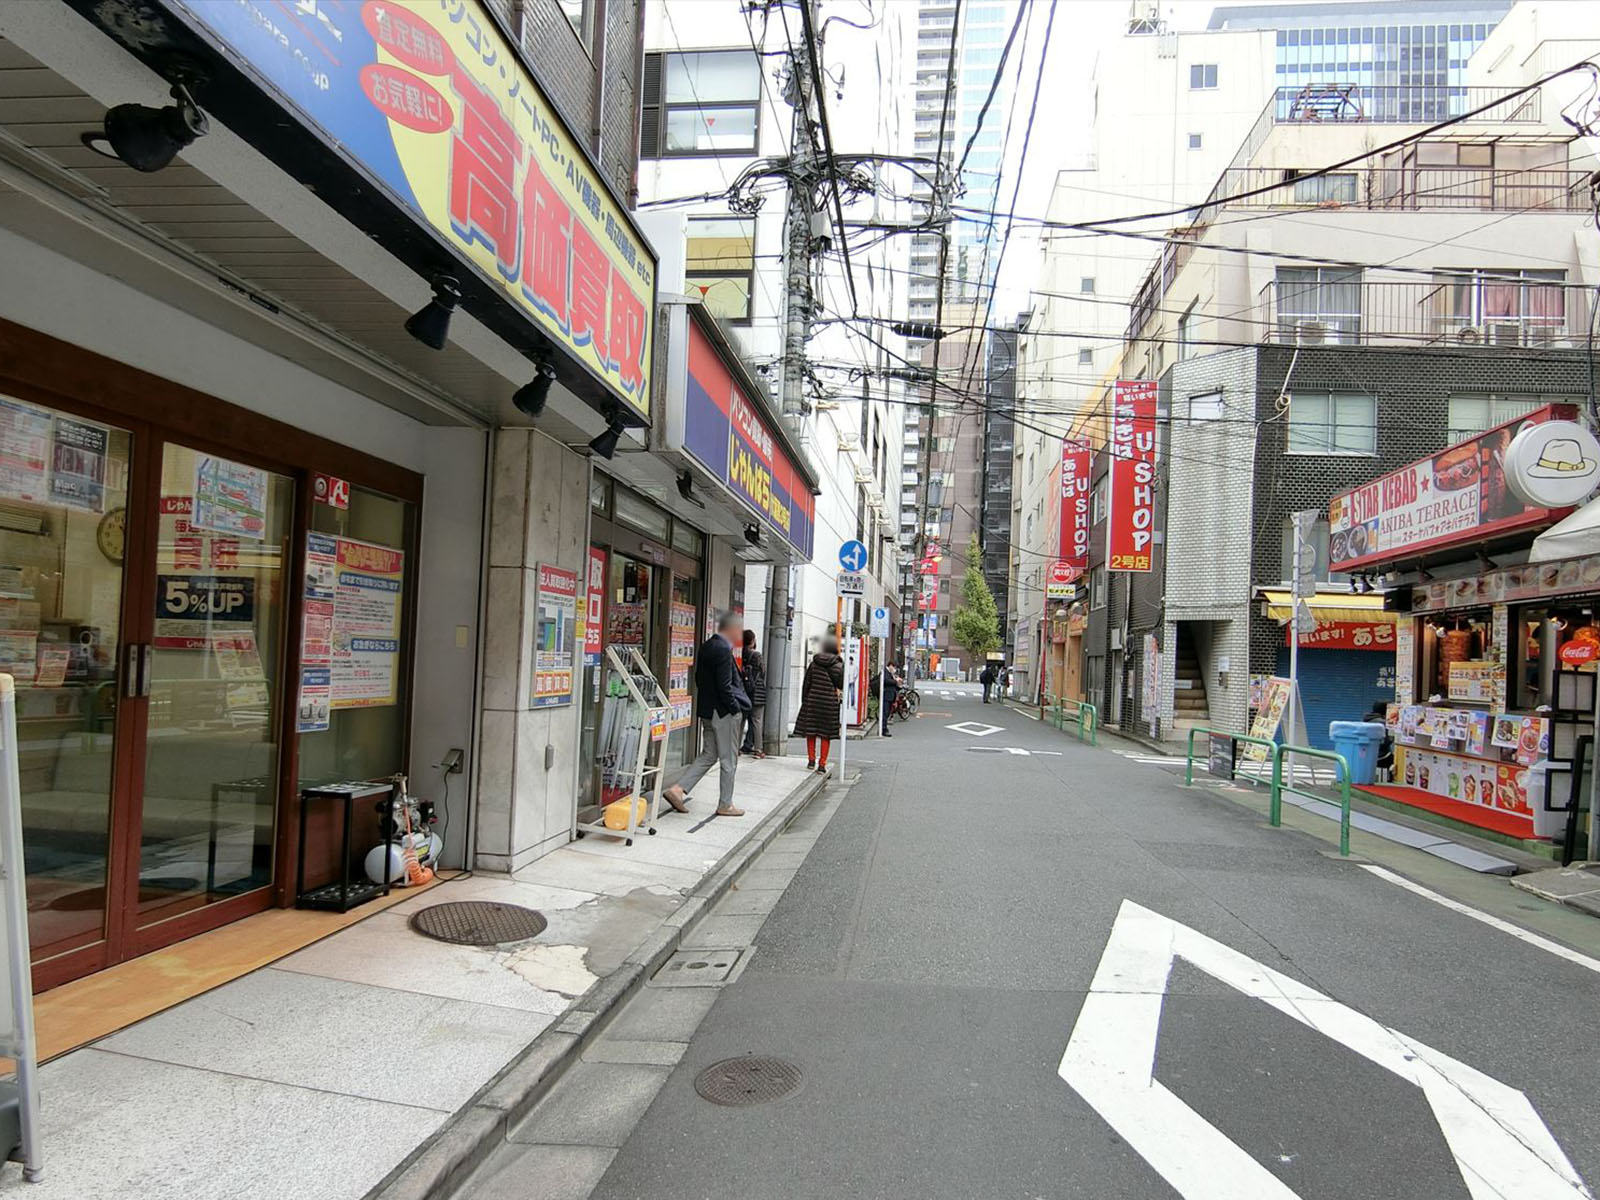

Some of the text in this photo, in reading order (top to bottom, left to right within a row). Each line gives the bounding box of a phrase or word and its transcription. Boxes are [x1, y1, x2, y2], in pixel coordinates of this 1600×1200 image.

[371, 6, 443, 69] 査定無料
[449, 57, 648, 403] 高価買取
[636, 260, 651, 287] etc
[1114, 404, 1135, 461] あきば
[730, 433, 771, 511] じゃんぱら
[1062, 459, 1077, 498] あきば
[1132, 431, 1153, 552] U-SHOP
[1350, 485, 1379, 525] STAR
[1382, 469, 1418, 512] KEBAB
[1073, 477, 1089, 557] U-SHOP
[1379, 490, 1478, 535] AKIBA TERRACE
[1111, 556, 1149, 569] 2号店
[165, 580, 244, 614] 5%UP
[1351, 624, 1394, 647] あき
[1562, 646, 1591, 659] Coca-Cola
